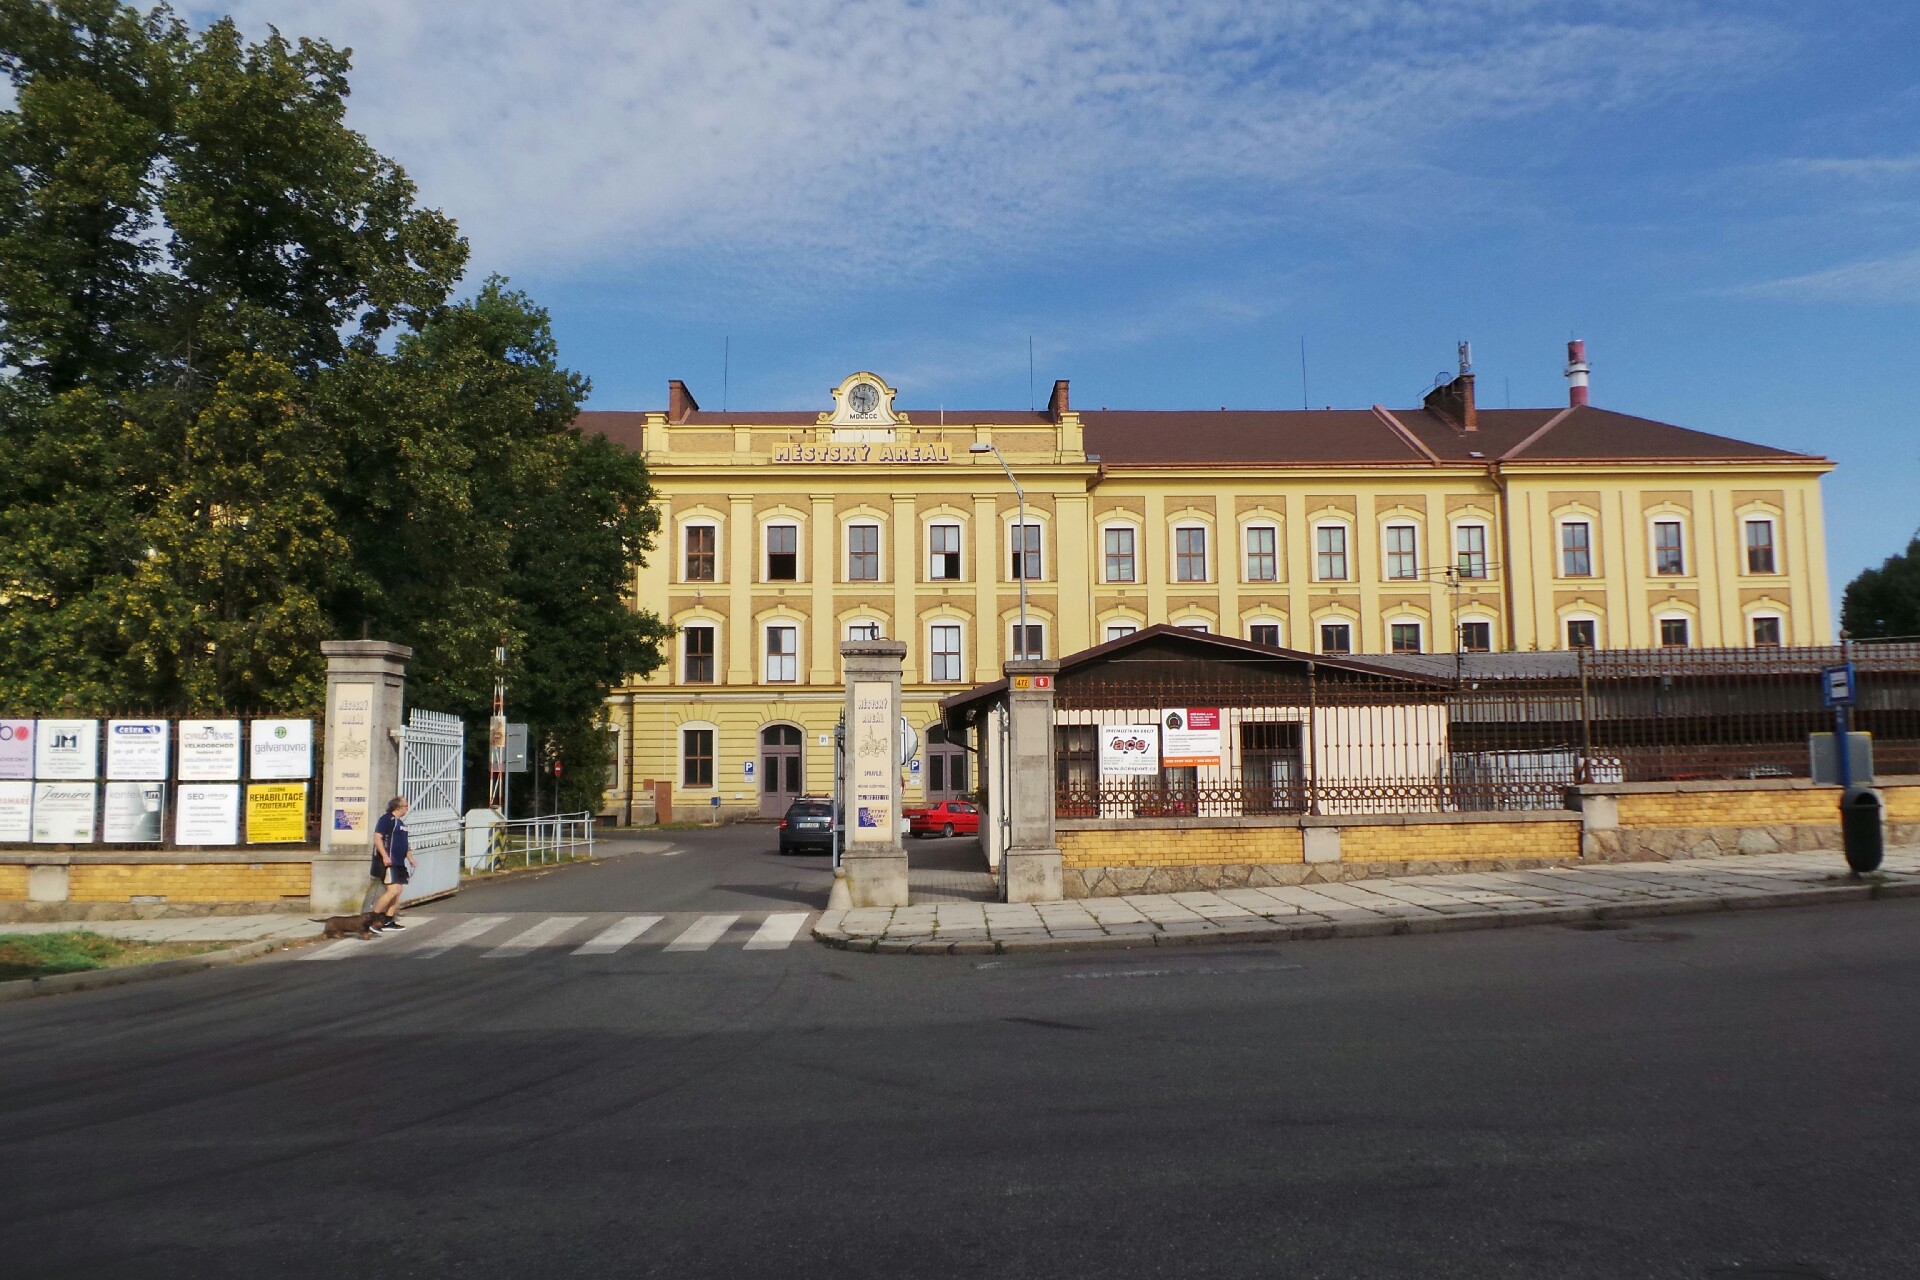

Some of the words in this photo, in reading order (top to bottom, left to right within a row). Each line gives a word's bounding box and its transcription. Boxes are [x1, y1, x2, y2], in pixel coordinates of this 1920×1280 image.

[774, 443, 871, 462] MĚSTSKÝ
[879, 443, 949, 462] AREÁL
[1016, 679, 1028, 687] 472
[1039, 678, 1045, 687] 6
[49, 735, 77, 748] JM
[1113, 739, 1146, 751] ace
[254, 741, 307, 755] galvanovna
[187, 792, 205, 800] SEO
[249, 793, 304, 802] REHABILITACE
